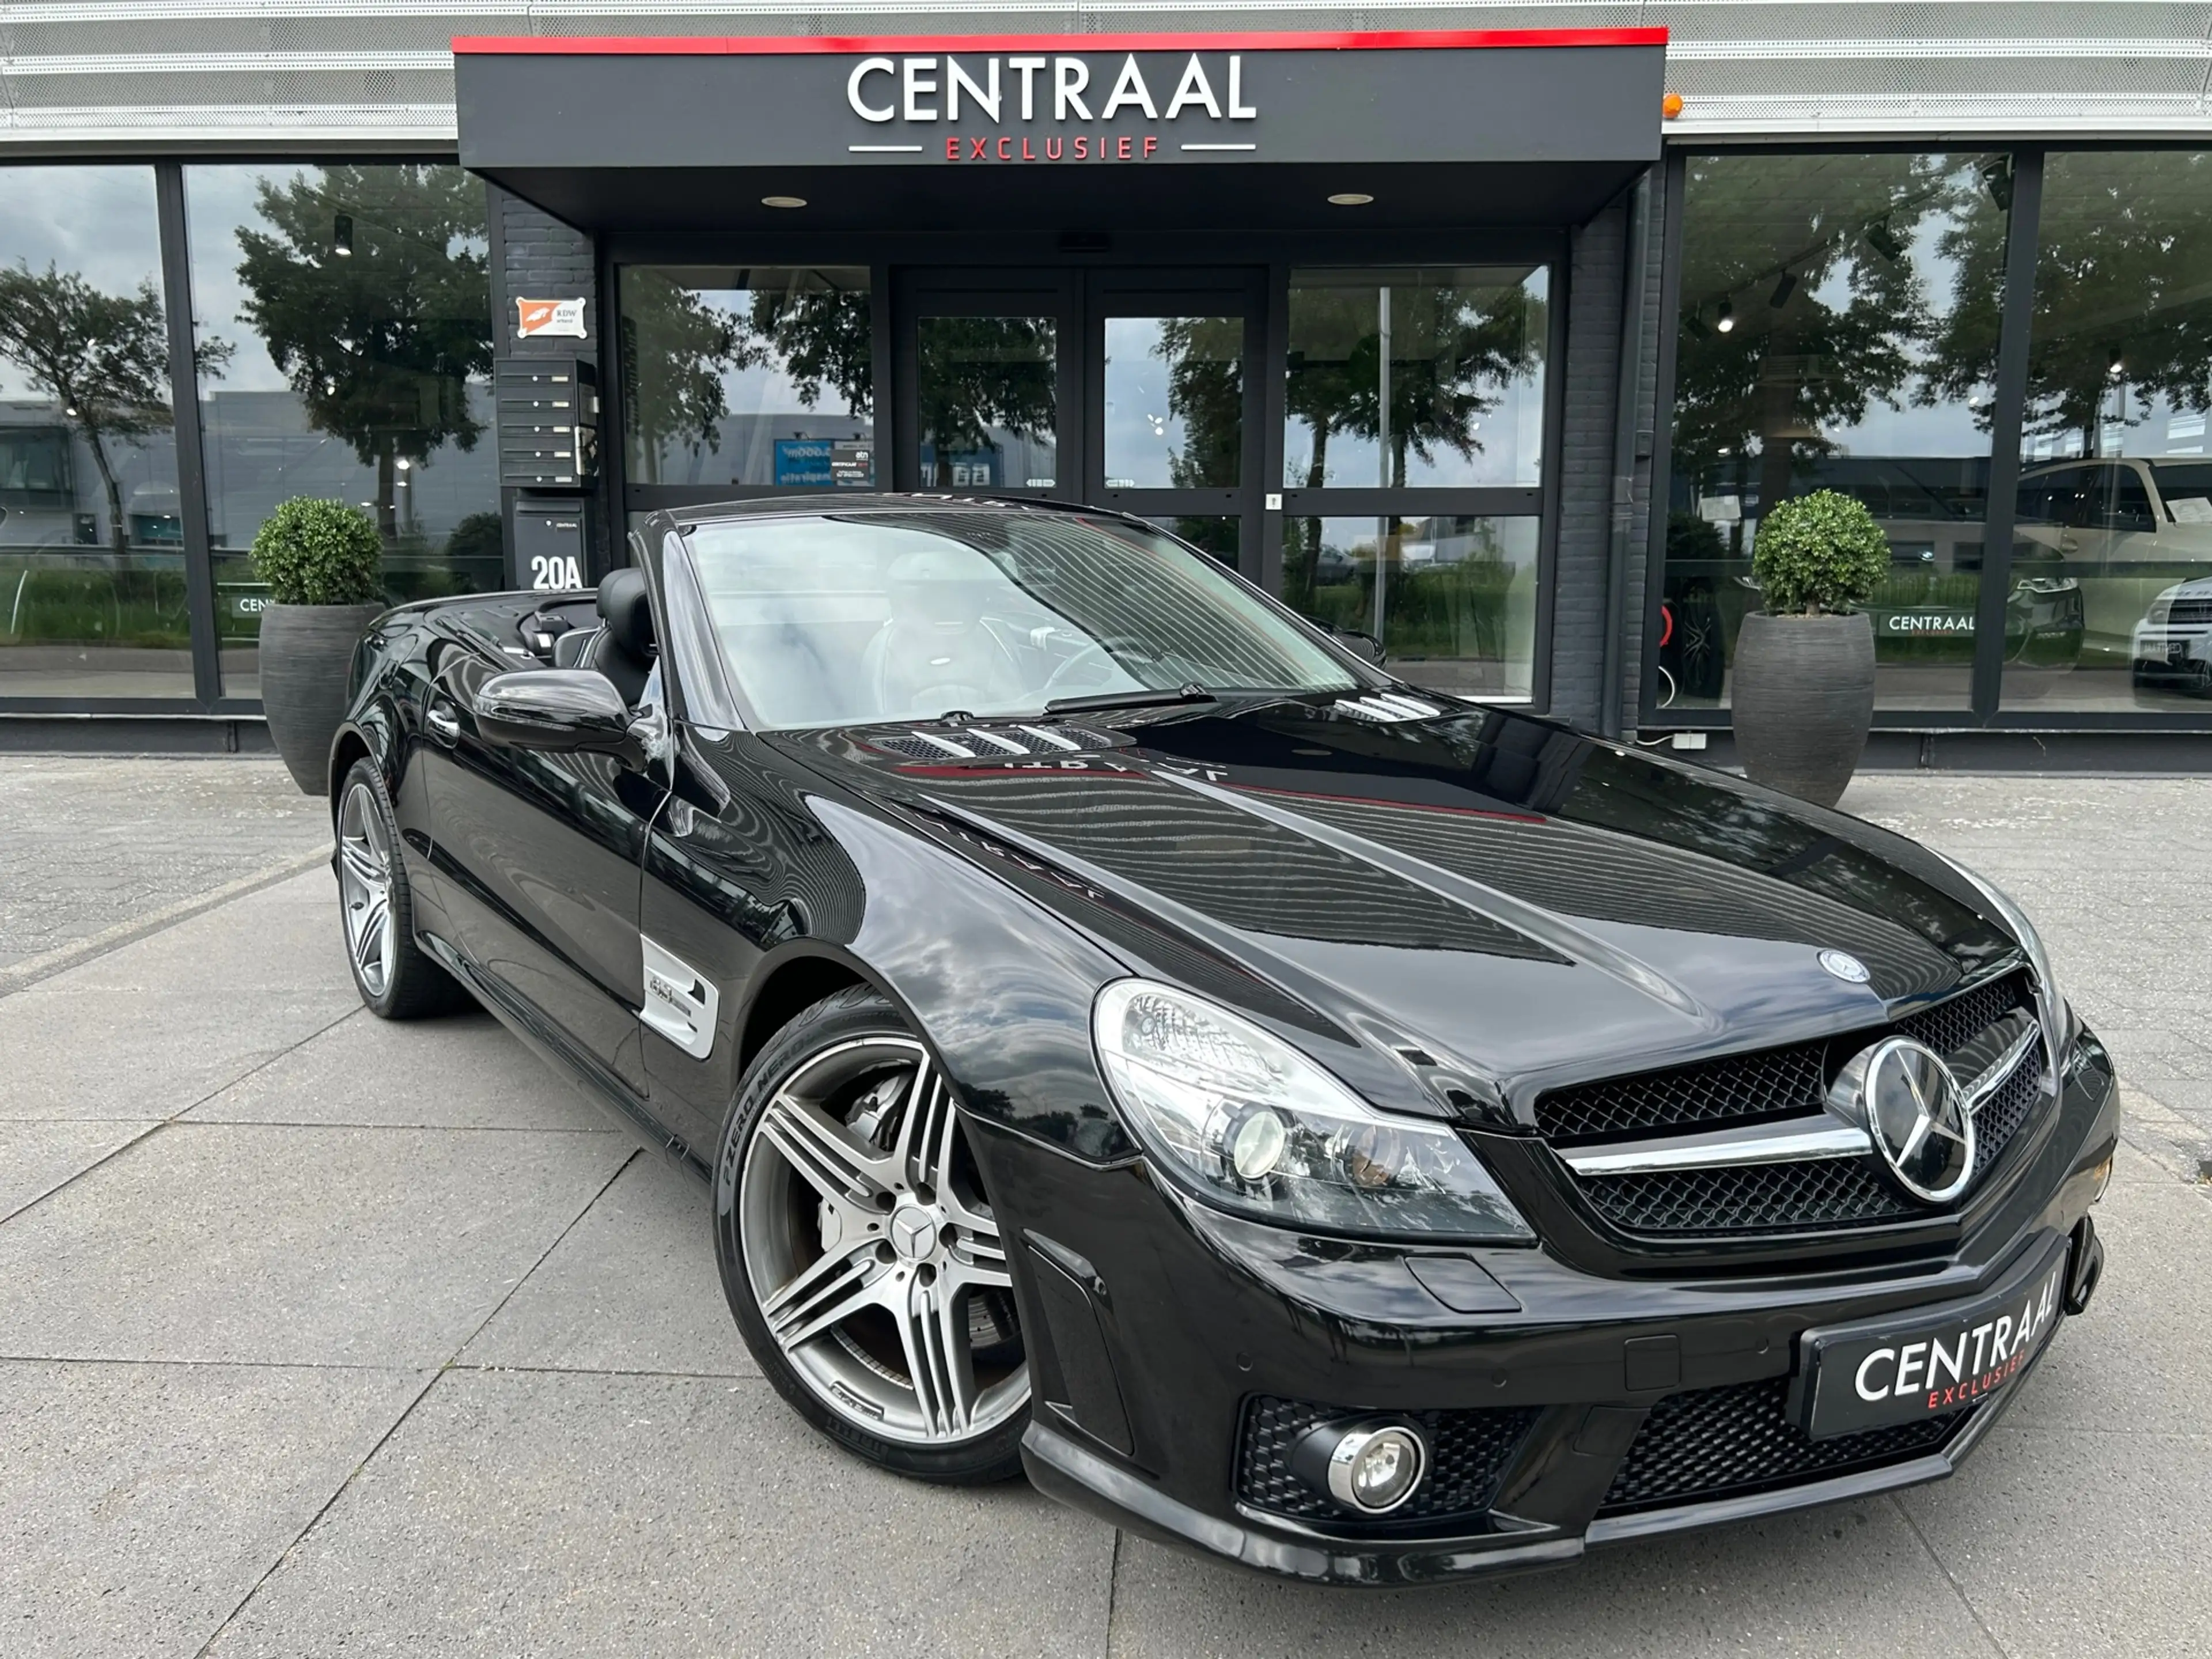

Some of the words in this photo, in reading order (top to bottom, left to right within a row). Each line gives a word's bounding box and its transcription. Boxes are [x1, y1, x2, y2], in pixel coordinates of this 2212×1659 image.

[847, 52, 1257, 123] CENTRAAL
[946, 136, 1158, 161] EXCLUSIEF
[531, 555, 583, 590] 20A
[1889, 616, 1975, 630] CENTRAAL
[1854, 1271, 2056, 1402] CENTRAAL
[1927, 1349, 2026, 1410] EXCLUSIEF
